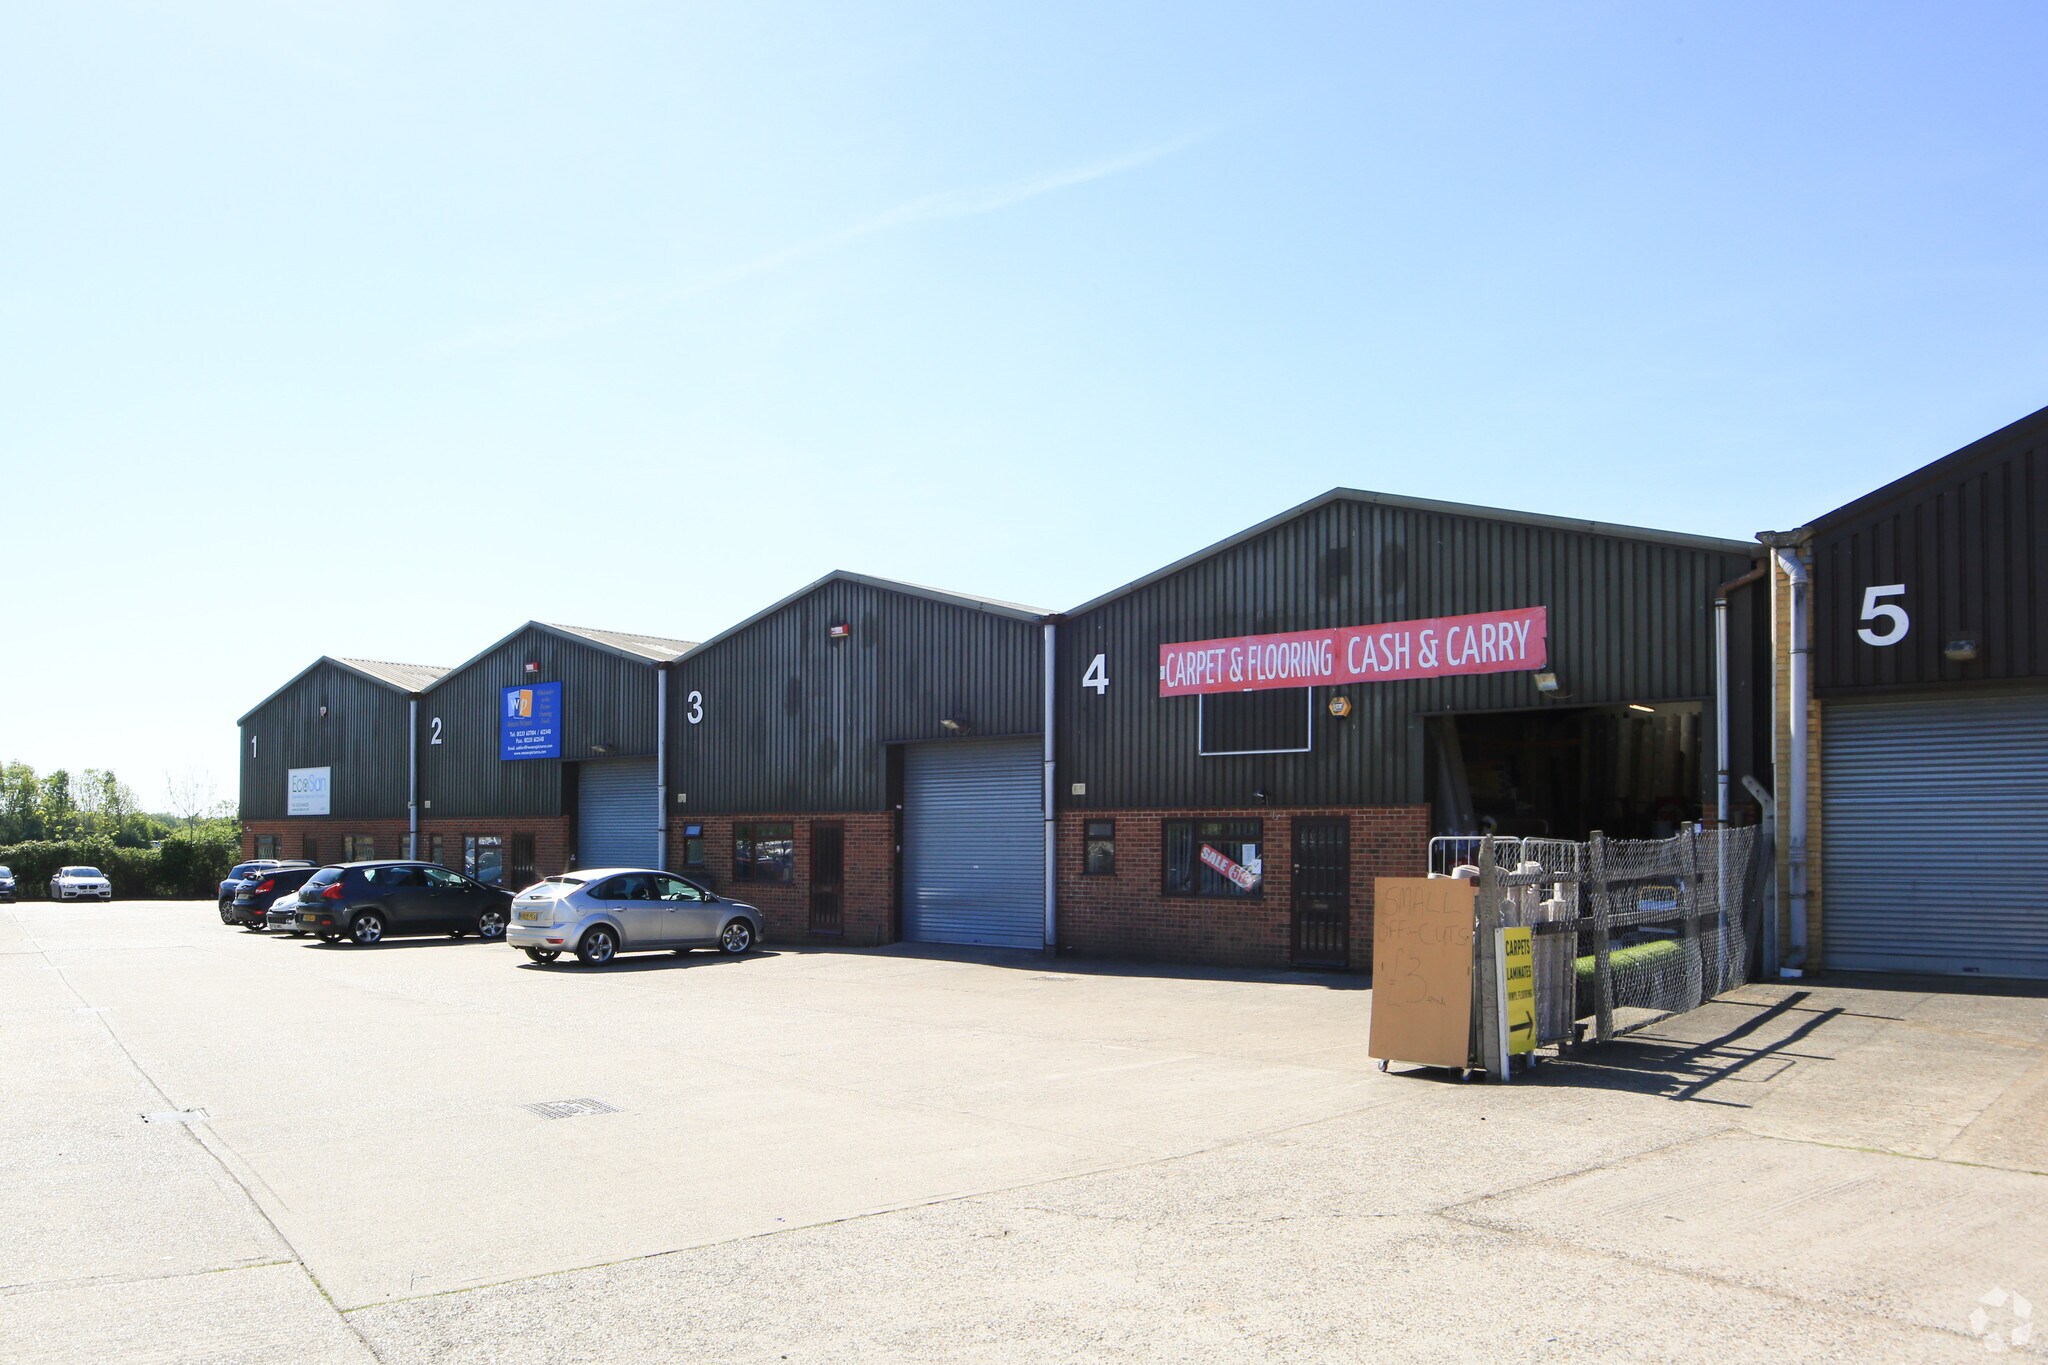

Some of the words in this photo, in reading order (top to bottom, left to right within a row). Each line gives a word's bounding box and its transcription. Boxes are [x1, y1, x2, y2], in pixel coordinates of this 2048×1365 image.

[1857, 583, 1910, 647] 5
[1166, 648, 1226, 688] CARPET
[1229, 647, 1244, 683] &
[1248, 638, 1332, 681] FLOORING
[1347, 631, 1410, 675] CASH
[1417, 629, 1439, 669] &
[1446, 619, 1531, 667] CARRY
[1082, 653, 1110, 695] 4
[687, 690, 704, 725] 3
[430, 717, 443, 745] 2
[251, 735, 257, 758] 1
[1200, 846, 1229, 872] SALE
[1382, 886, 1462, 917] SMALL
[1505, 938, 1531, 957] CARPETS
[1506, 965, 1532, 981] LAMINATES
